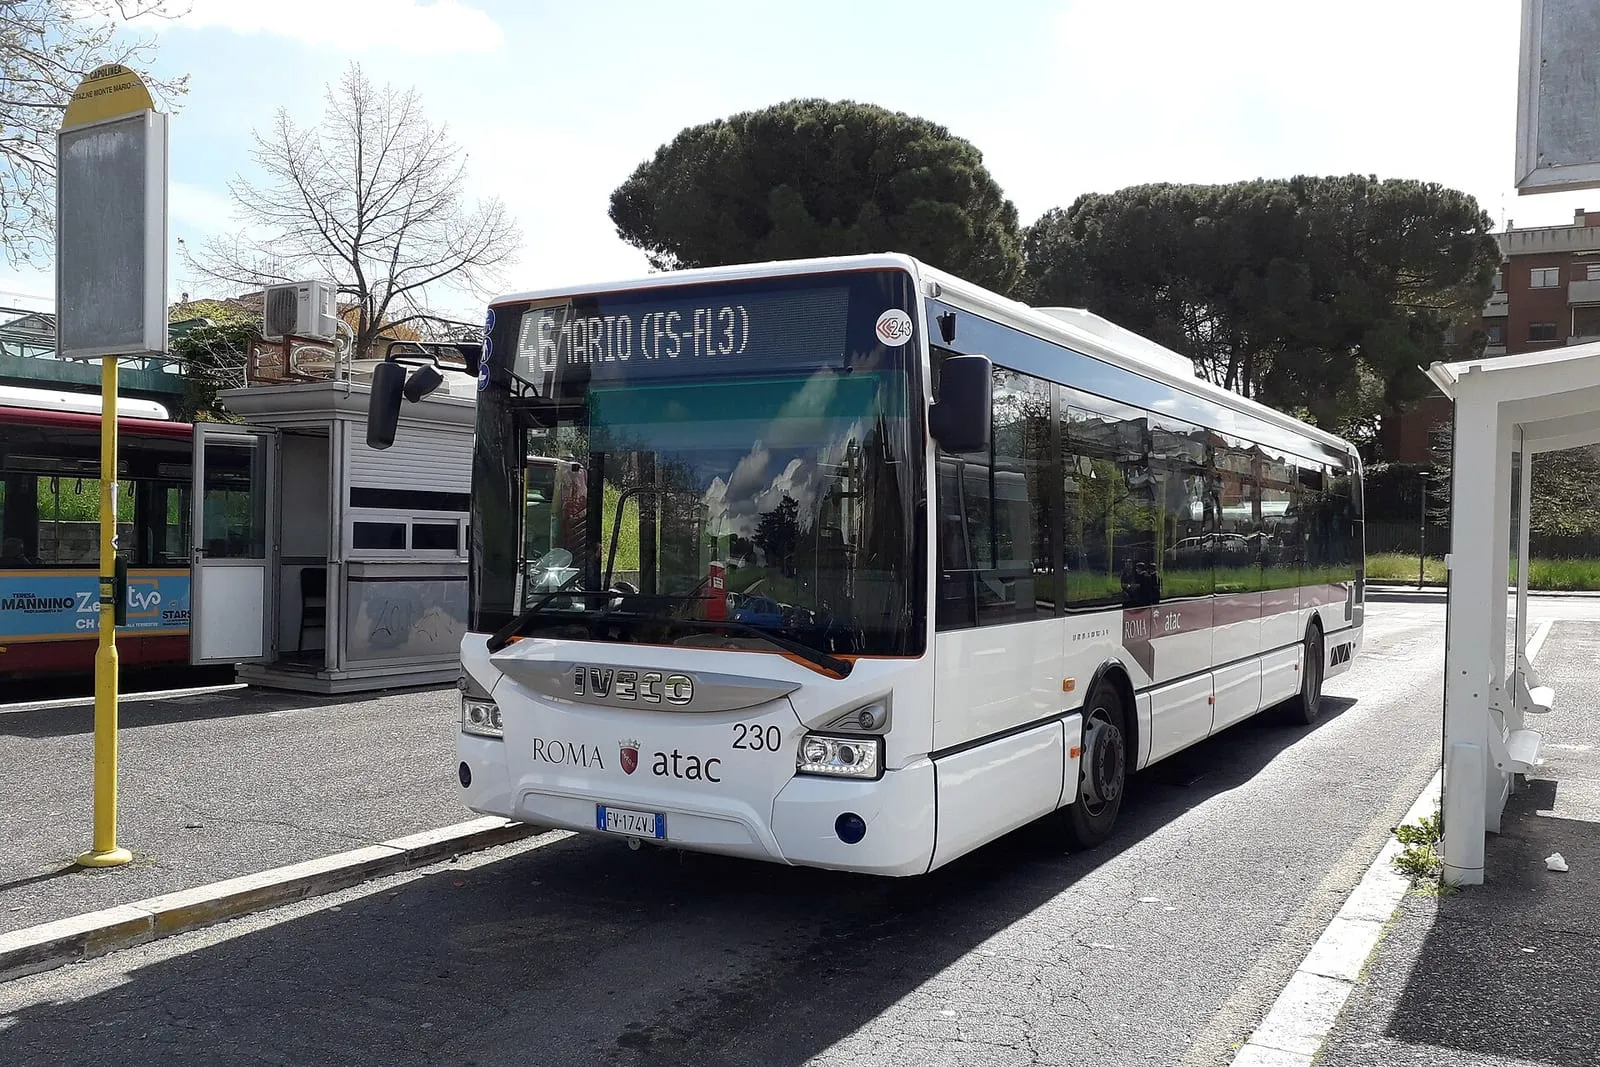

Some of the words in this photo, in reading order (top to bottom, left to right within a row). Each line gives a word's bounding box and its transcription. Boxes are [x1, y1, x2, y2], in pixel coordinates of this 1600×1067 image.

[89, 64, 122, 80] CAPOLINEA
[94, 86, 112, 96] MONTE
[113, 82, 131, 92] MARIO
[891, 320, 912, 336] 243
[519, 316, 556, 374] 46
[640, 305, 750, 359] (FS-FL3)
[1, 597, 75, 611] MANNINO
[75, 618, 95, 629] CH
[1124, 618, 1147, 640] ROMA
[1164, 612, 1181, 631] atac
[573, 667, 695, 705] IVECO
[732, 723, 782, 752] 230
[532, 738, 605, 769] ROMA
[652, 749, 721, 783] atac
